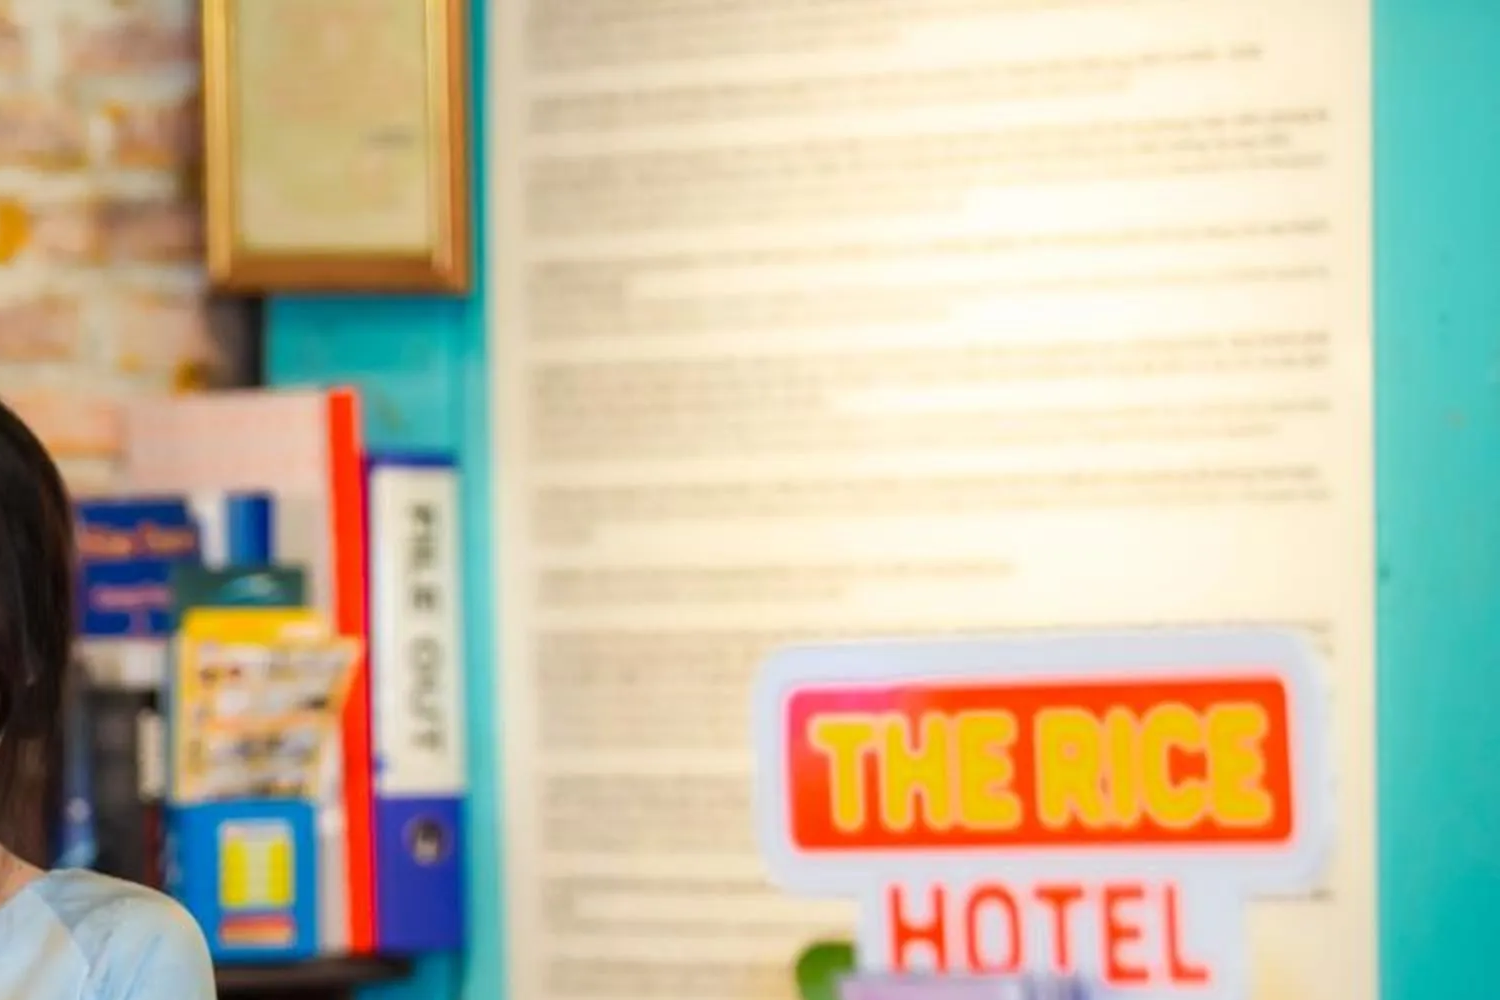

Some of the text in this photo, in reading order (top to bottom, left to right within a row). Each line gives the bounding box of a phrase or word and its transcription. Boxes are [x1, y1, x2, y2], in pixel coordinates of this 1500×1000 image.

[807, 710, 1023, 832] THE
[1033, 703, 1274, 828] RICE
[888, 884, 1212, 985] HOTEL
